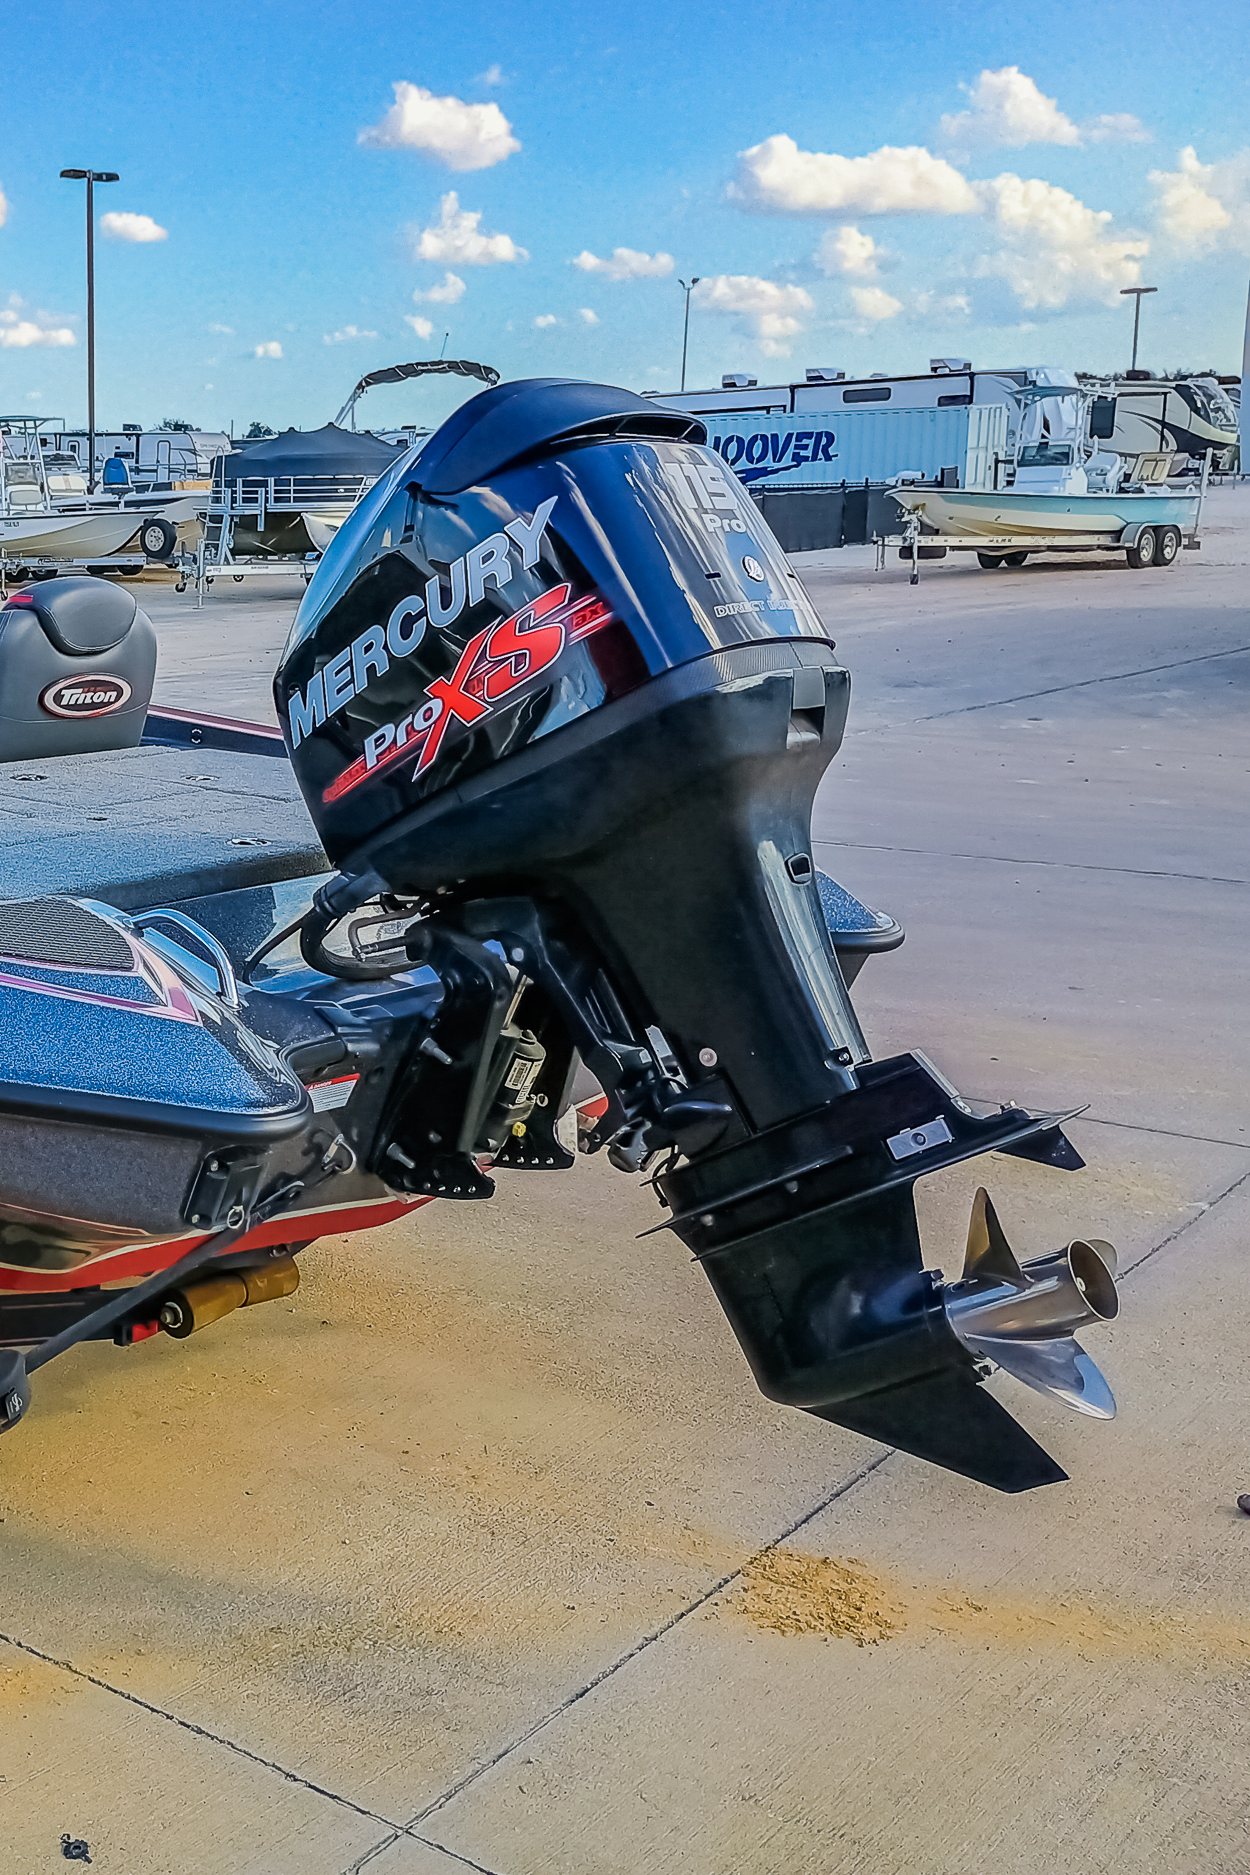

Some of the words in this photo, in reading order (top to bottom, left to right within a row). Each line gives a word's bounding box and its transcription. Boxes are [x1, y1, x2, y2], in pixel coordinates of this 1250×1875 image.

[664, 463, 737, 510] 115
[701, 513, 748, 534] Pro
[713, 600, 766, 619] DIRECT
[287, 495, 559, 750] MERCURY
[61, 688, 117, 706] Triton
